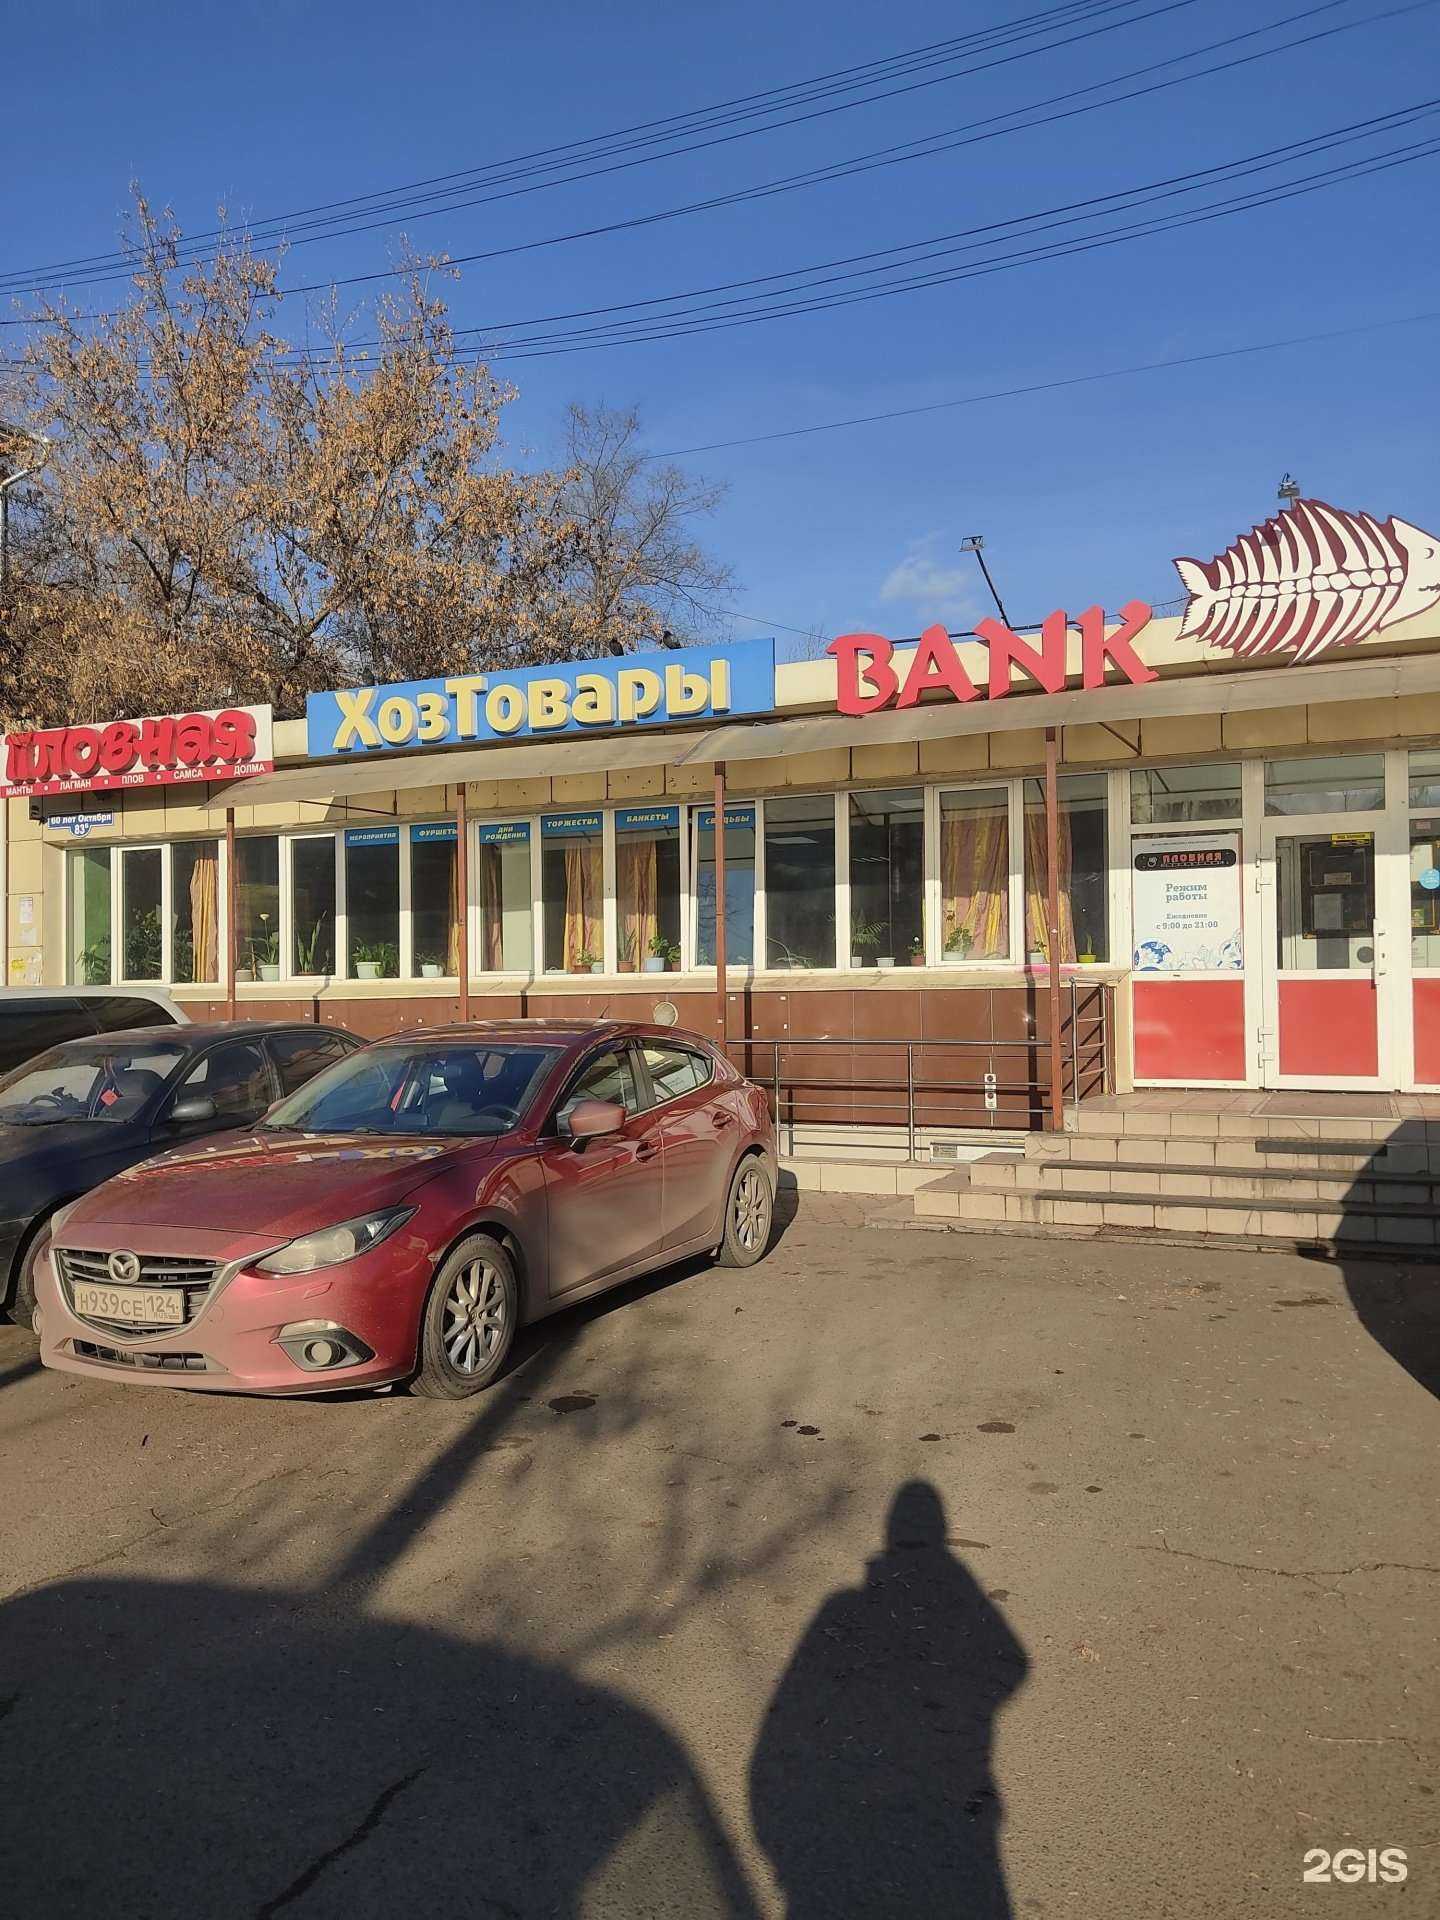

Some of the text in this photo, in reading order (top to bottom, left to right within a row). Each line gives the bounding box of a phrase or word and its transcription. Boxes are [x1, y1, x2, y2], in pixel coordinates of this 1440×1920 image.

[826, 599, 1160, 715] BANK
[6, 764, 265, 795] МАНТЫ ЛАГМАН ПЛОВ САМСА ДОЛМА
[546, 817, 599, 828] ТОРЖЕСТВА
[626, 813, 670, 823] БАНКЕТЫ
[497, 826, 514, 834] ДНИ
[485, 831, 527, 841] РОЖДЕНИЯ
[146, 1295, 176, 1314] 124
